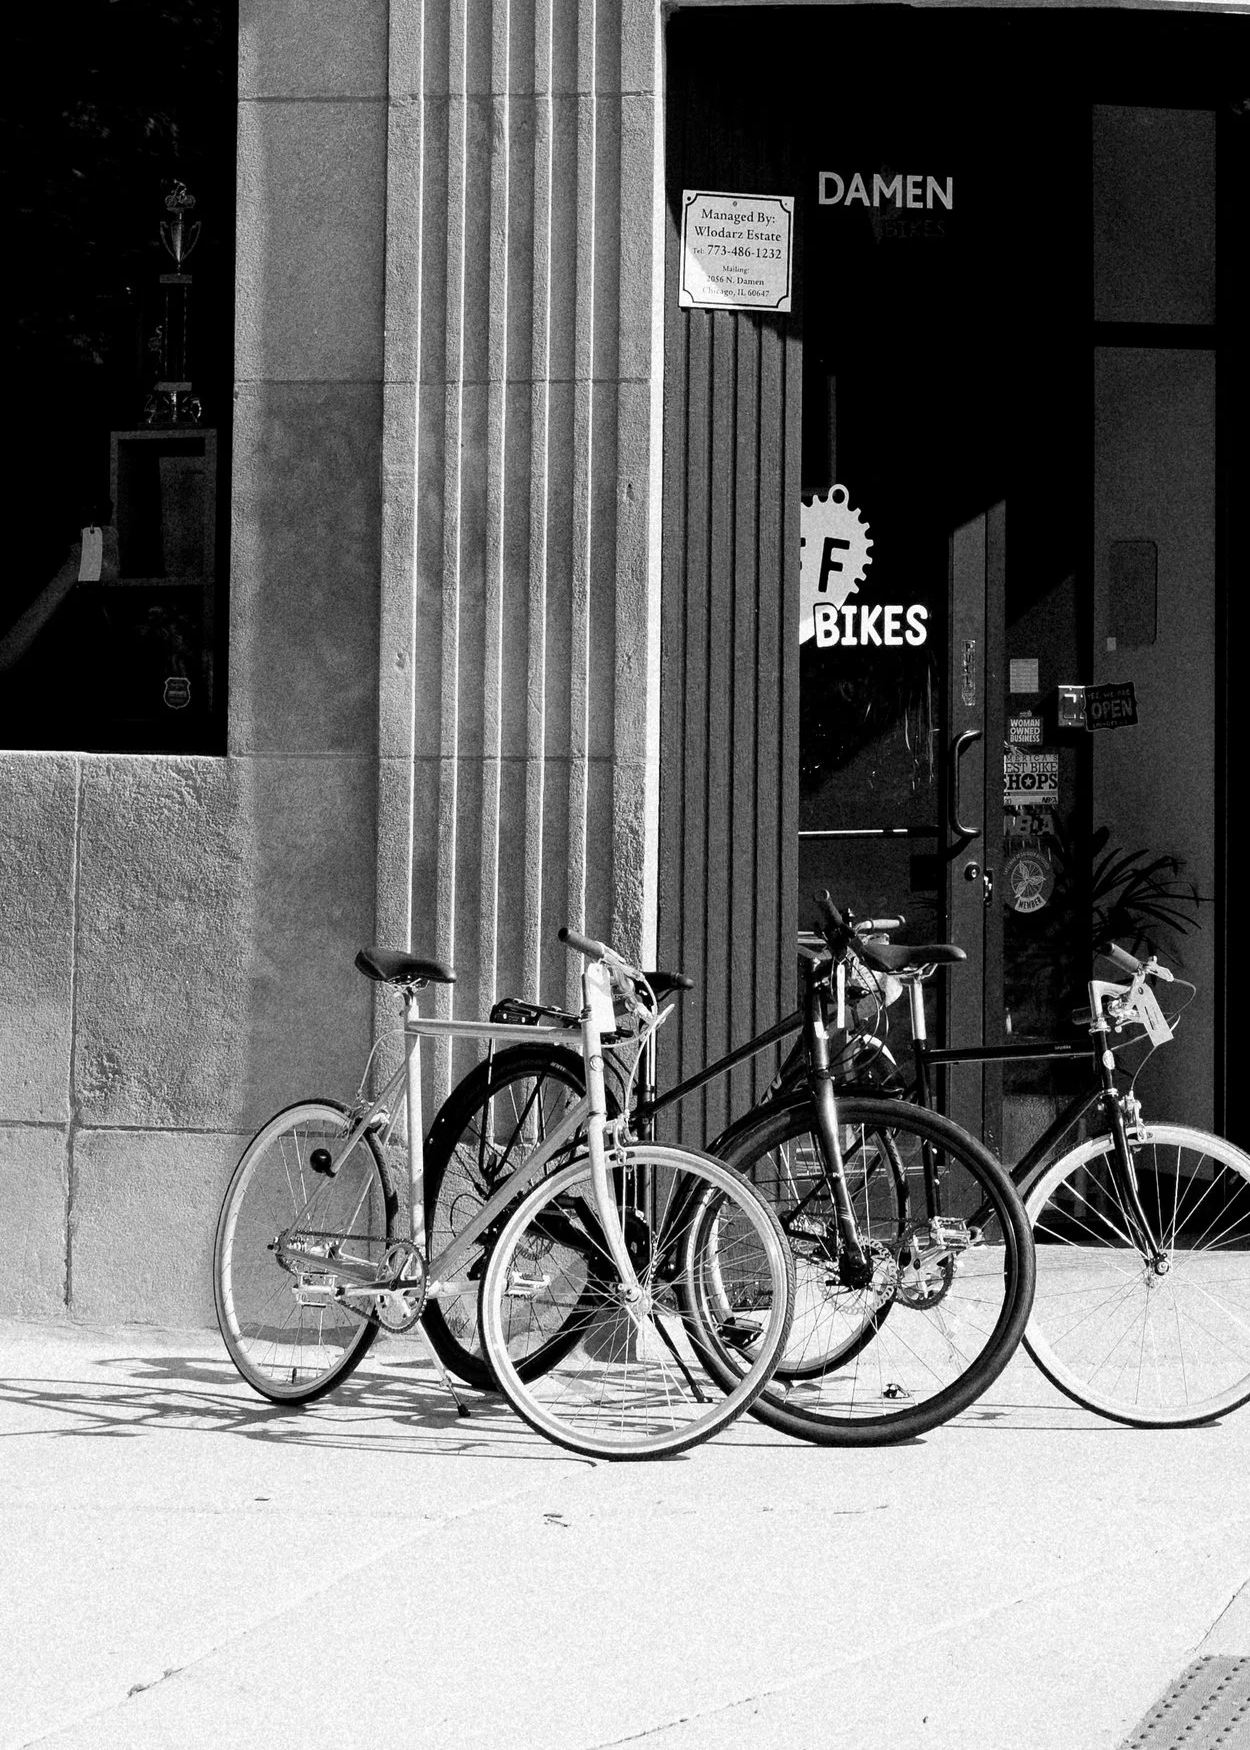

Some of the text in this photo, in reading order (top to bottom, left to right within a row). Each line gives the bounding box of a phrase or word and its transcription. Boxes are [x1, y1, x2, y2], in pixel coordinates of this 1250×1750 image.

[818, 171, 954, 210] DAMEN
[701, 208, 776, 227] Managed By:
[694, 225, 782, 242] Wlodarz Estate
[692, 244, 782, 259] Tel: 773-486-1232
[722, 265, 750, 275] Mailing:
[726, 276, 735, 284] N.
[737, 277, 765, 286] Damen
[747, 289, 770, 297] 60647
[814, 603, 928, 648] BIKES
[1091, 698, 1133, 720] OPEN
[1010, 718, 1041, 727] WOMAN
[1010, 727, 1041, 735] OWNED
[1010, 734, 1040, 743] BUSINESS
[1005, 762, 1058, 773] EST BIKE
[1018, 896, 1042, 909] MEMBER
